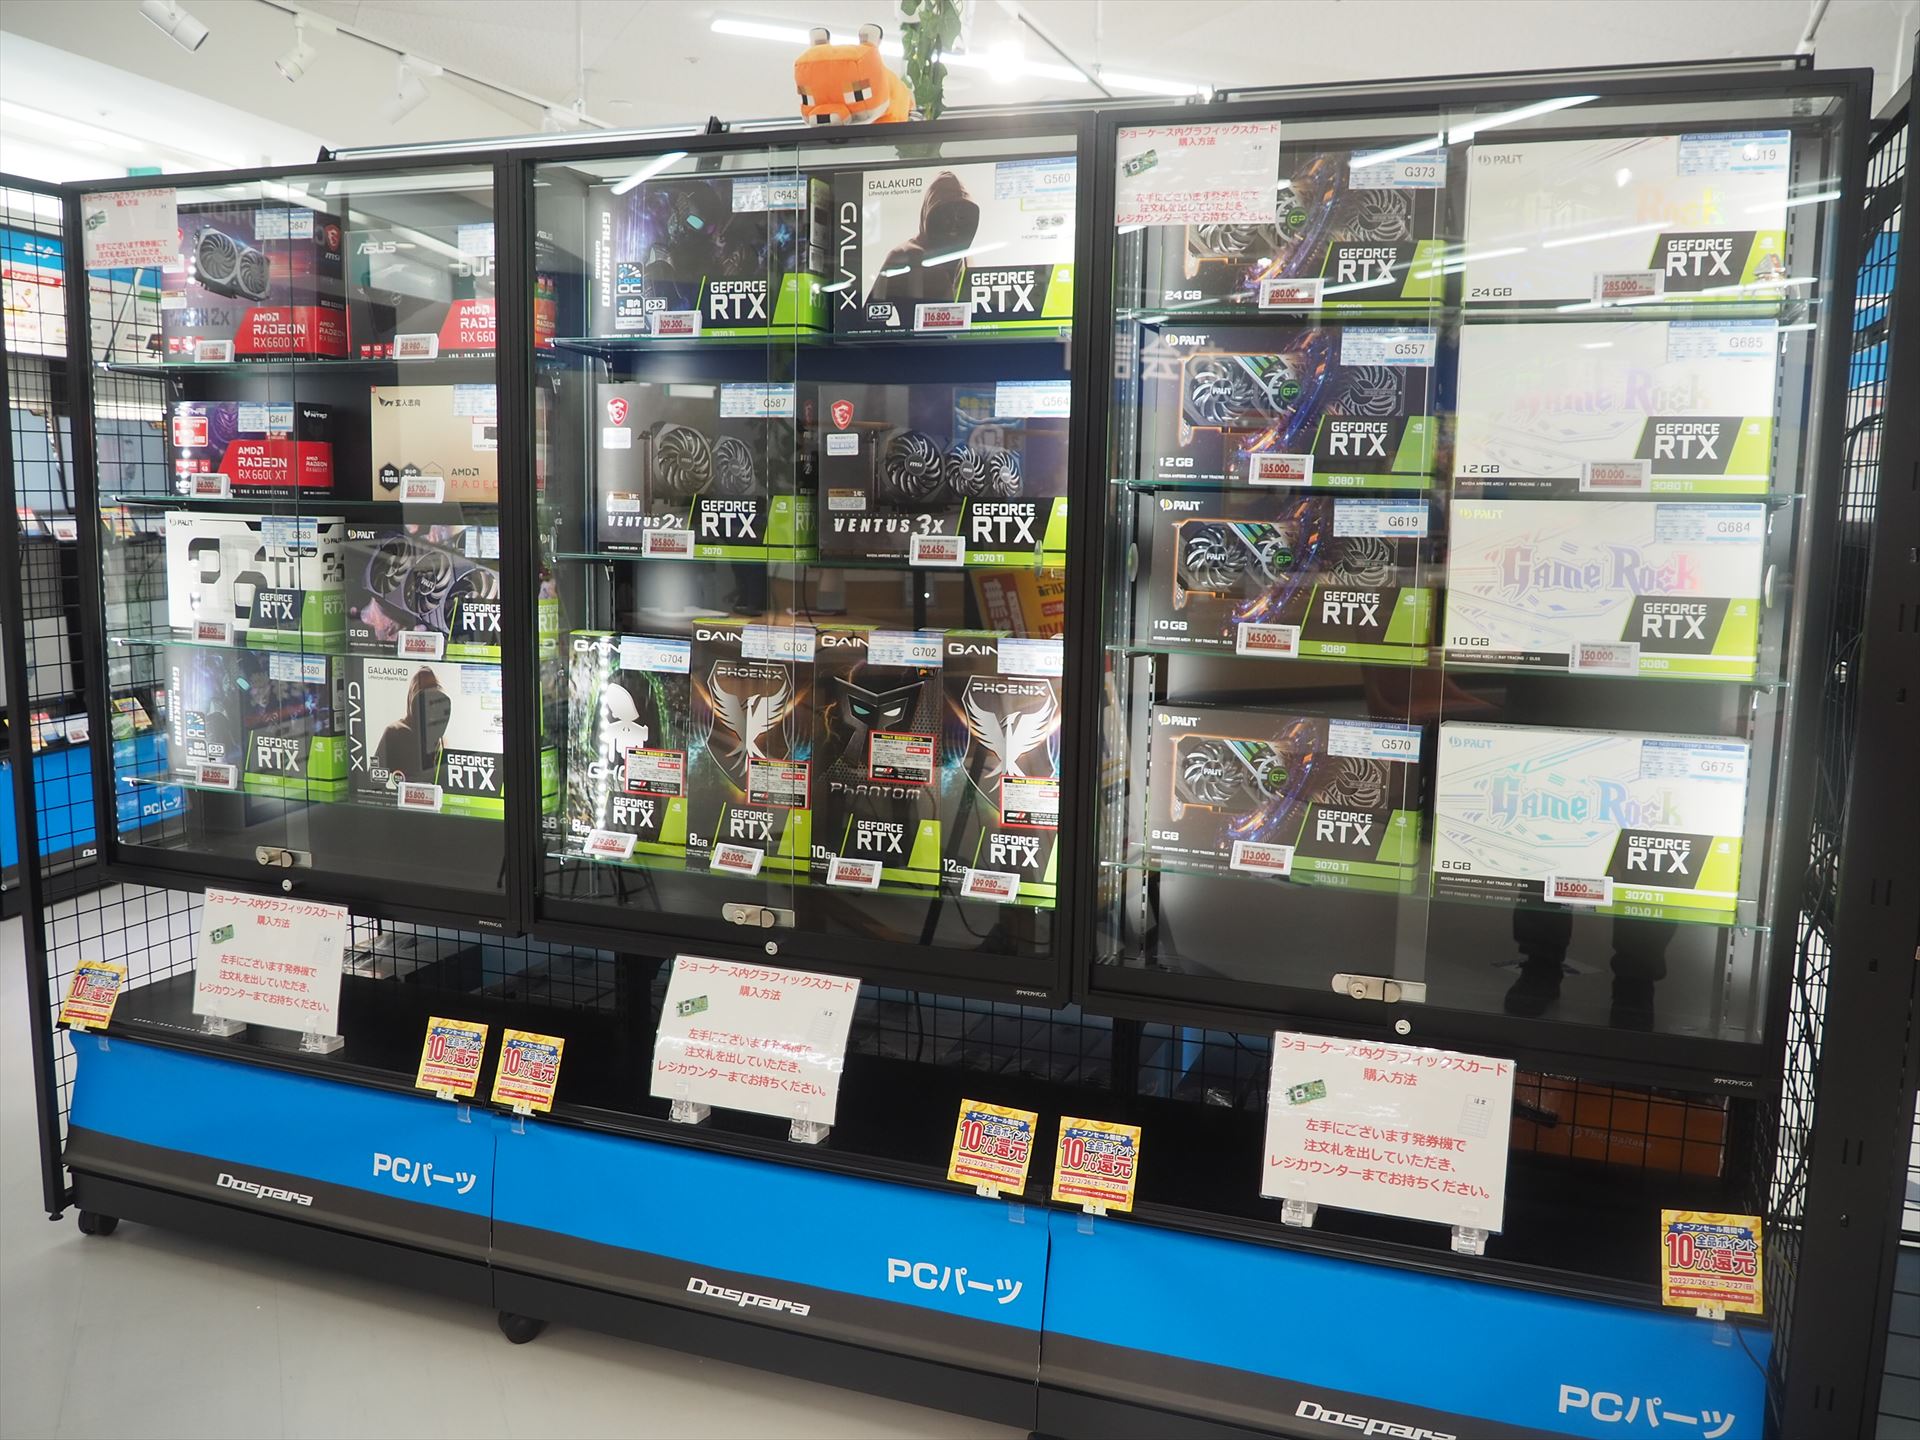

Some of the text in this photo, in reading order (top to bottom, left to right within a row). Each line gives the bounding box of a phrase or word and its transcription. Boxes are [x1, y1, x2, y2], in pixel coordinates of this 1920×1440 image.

[1119, 124, 1278, 139] ショーケース内グラフィックスカード
[1178, 138, 1217, 147] 購入方法
[1492, 154, 1523, 165] PALIT
[1044, 173, 1071, 184] G560
[1405, 166, 1435, 177] G373
[869, 178, 923, 190] GALAKURO
[774, 191, 798, 200] G643
[357, 240, 397, 255] ASUS
[1668, 238, 1732, 251] GEFORCE
[602, 212, 611, 308] GALAKURO
[840, 202, 857, 310] GALAX
[1339, 247, 1397, 259] GEFORCE
[1337, 260, 1396, 283] RTX
[1666, 252, 1732, 277] RTX
[971, 271, 1035, 285] GEFORCE
[618, 284, 641, 293] OC
[711, 281, 767, 293] GEFORCE
[971, 285, 1035, 314] RTX
[710, 294, 767, 320] RTX
[253, 325, 306, 335] RADEON
[460, 318, 495, 329] RADE
[1179, 335, 1206, 345] PALIT
[1730, 337, 1763, 348] G685
[1395, 343, 1425, 355] G557
[764, 399, 786, 408] G587
[270, 415, 287, 424] G641
[1331, 422, 1388, 433] GEFORCE
[1656, 423, 1720, 435] GEFORCE
[1329, 434, 1386, 456] RTX
[1654, 435, 1718, 460] RTX
[238, 457, 288, 468] RADEON
[1159, 457, 1194, 467] 12 GB
[1462, 464, 1500, 474] 12 GB
[1328, 477, 1364, 485] 3080 Ti
[701, 501, 757, 513] GEFORCE
[972, 503, 1036, 516] GEFORCE
[1173, 500, 1201, 511] PALIT
[701, 514, 757, 539] RTX
[1388, 516, 1418, 527] G619
[1717, 521, 1751, 533] G684
[291, 531, 311, 539] G583
[356, 531, 375, 540] PALIT
[972, 516, 1036, 543] RTX
[973, 553, 1004, 562] 3070 Ti
[1501, 544, 1702, 598] Game Rock
[259, 593, 293, 602] GEFORCE
[1324, 591, 1380, 604] GEFORCE
[259, 602, 294, 620] RTX
[463, 603, 500, 612] GEFORCE
[1322, 602, 1379, 627] RTX
[1643, 603, 1707, 616] GEFORCE
[463, 612, 501, 632] RTX
[1154, 620, 1188, 631] 10 GB
[1642, 615, 1705, 640] RTX
[784, 642, 807, 653] G703
[1321, 644, 1346, 654] 3080
[1453, 637, 1490, 647] 10 GB
[660, 654, 683, 664] G704
[912, 647, 937, 657] G702
[1640, 659, 1669, 669] 3080
[368, 666, 408, 677] GALAKURO
[716, 666, 785, 680] PHOENIX
[972, 683, 1047, 696] PHOENIX
[348, 681, 364, 772] GALAX
[1170, 716, 1198, 727] PALIT
[257, 736, 299, 750] GEFORCE
[1381, 739, 1411, 751] G570
[1463, 737, 1493, 749] PALIT
[257, 747, 300, 772] RTX
[447, 754, 495, 767] GEFORCE
[1700, 760, 1734, 773] G675
[447, 766, 496, 792] RTX
[830, 782, 921, 800] PHANTOM
[613, 797, 655, 810] GEFORCE
[1489, 776, 1684, 829] Game Rock
[613, 809, 655, 829] RTX
[730, 809, 774, 822] GEFORCE
[1318, 810, 1373, 824] GEFORCE
[730, 820, 774, 842] RTX
[857, 820, 903, 833] GEFORCE
[1316, 820, 1372, 846] RTX
[689, 833, 708, 847] 8GB
[857, 831, 903, 854] RTX
[990, 834, 1040, 848] GEFORCE
[1628, 836, 1691, 851] GEFORCE
[990, 844, 1039, 868] RTX
[1627, 847, 1690, 875] RTX
[1315, 861, 1350, 872] 3070 Ti
[1625, 890, 1664, 902] 3070 Ti
[208, 892, 344, 920] ショーケース内グラフィックスカード
[257, 915, 291, 929] 購入方法
[220, 954, 317, 978] 左手にございます発券機で
[219, 969, 311, 994] 注文札を出していただき、
[678, 960, 855, 993] ショーケース内グラフィックスカード
[199, 982, 330, 1013] レジカウンターまでお持ちください。
[739, 985, 782, 1001] 購入方法
[427, 1034, 480, 1069] 10%還元
[1281, 1036, 1508, 1077] ショーケース内グラフィックスカード
[502, 1047, 556, 1083] 10%還元
[684, 1047, 803, 1074] 注文札を出していただき、
[658, 1060, 827, 1097] レジカウンターまでお持ちください。
[1363, 1068, 1418, 1087] 購入方法
[984, 1124, 1032, 1141] 全品ポイント
[1071, 1129, 1128, 1142] オープンセール期間中
[1306, 1118, 1467, 1152] 左手にございます発券機で
[960, 1120, 1029, 1163] 10%還元
[1085, 1140, 1136, 1157] 全品ポイント
[1060, 1137, 1133, 1178] 10%還元
[1304, 1138, 1458, 1173] 注文札を出していただき、
[372, 1152, 477, 1195] PCパーツ
[1270, 1154, 1491, 1200] レジカウンターまでお持ちください。
[216, 1172, 314, 1207] Dospara
[1676, 1223, 1745, 1235] オープンセール期間中
[1694, 1234, 1758, 1252] 全品ポイント
[1665, 1232, 1758, 1276] 10%還元
[887, 1257, 1023, 1305] PCパーツ
[685, 1276, 811, 1317] Dospara
[1558, 1384, 1736, 1440] PCパーツ
